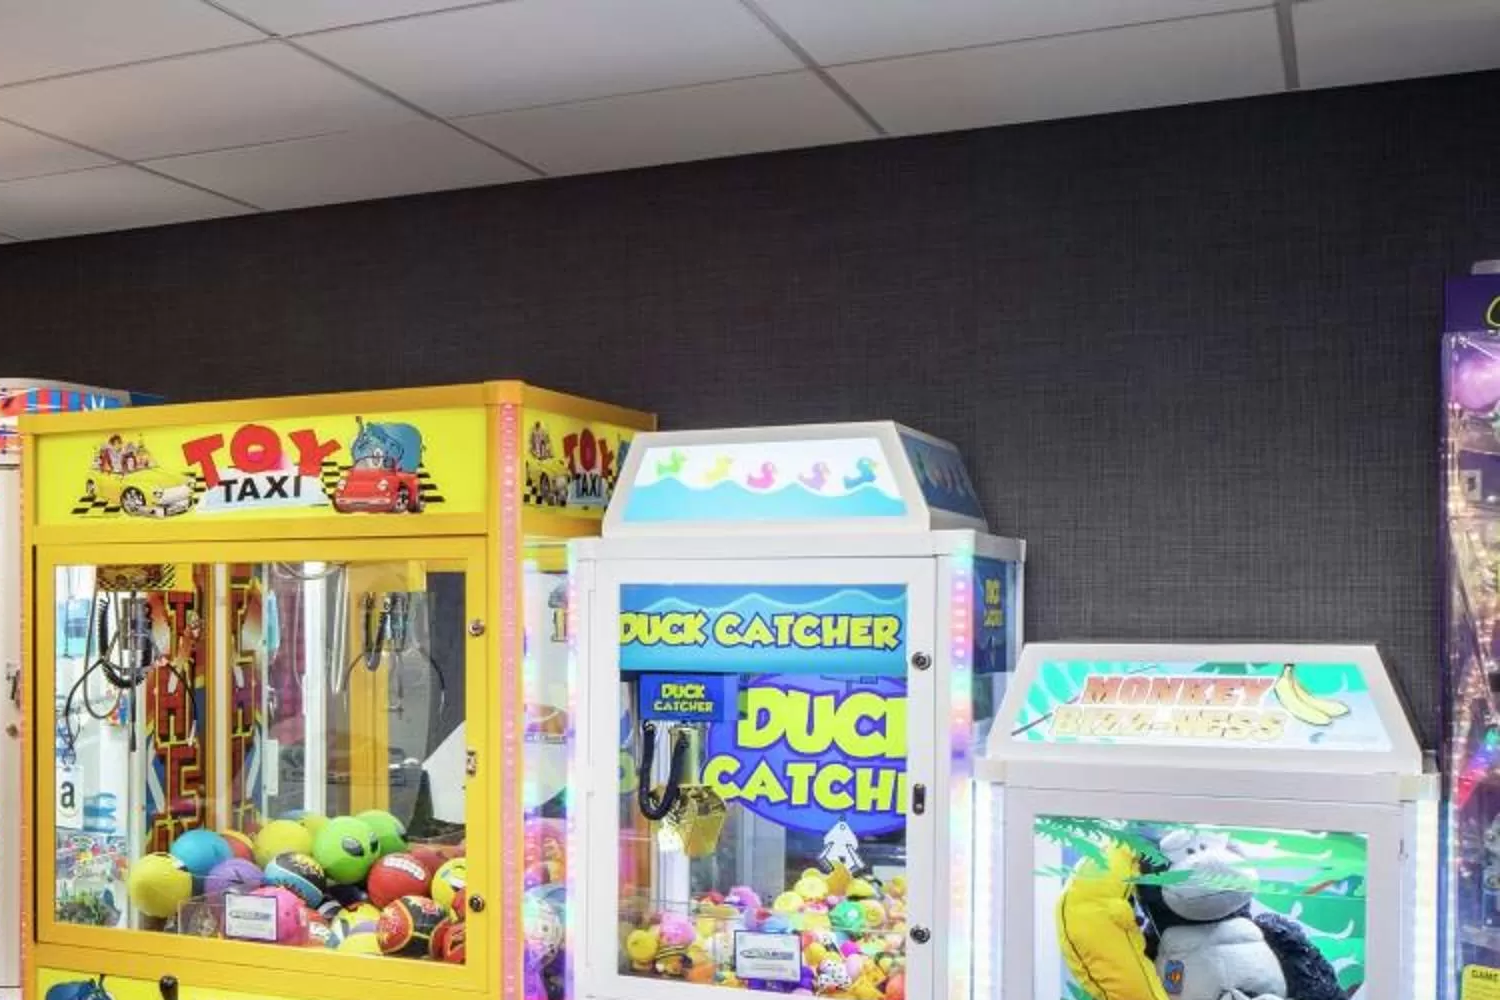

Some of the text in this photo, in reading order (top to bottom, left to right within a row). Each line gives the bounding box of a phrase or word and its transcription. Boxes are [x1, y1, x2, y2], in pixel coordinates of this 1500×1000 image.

[182, 424, 342, 489] TOY
[218, 475, 301, 503] TAXI
[620, 611, 902, 651] DUCK CATCHER
[660, 683, 705, 699] DUCK
[1080, 674, 1277, 706] MONKEY
[653, 700, 715, 713] CATCHER
